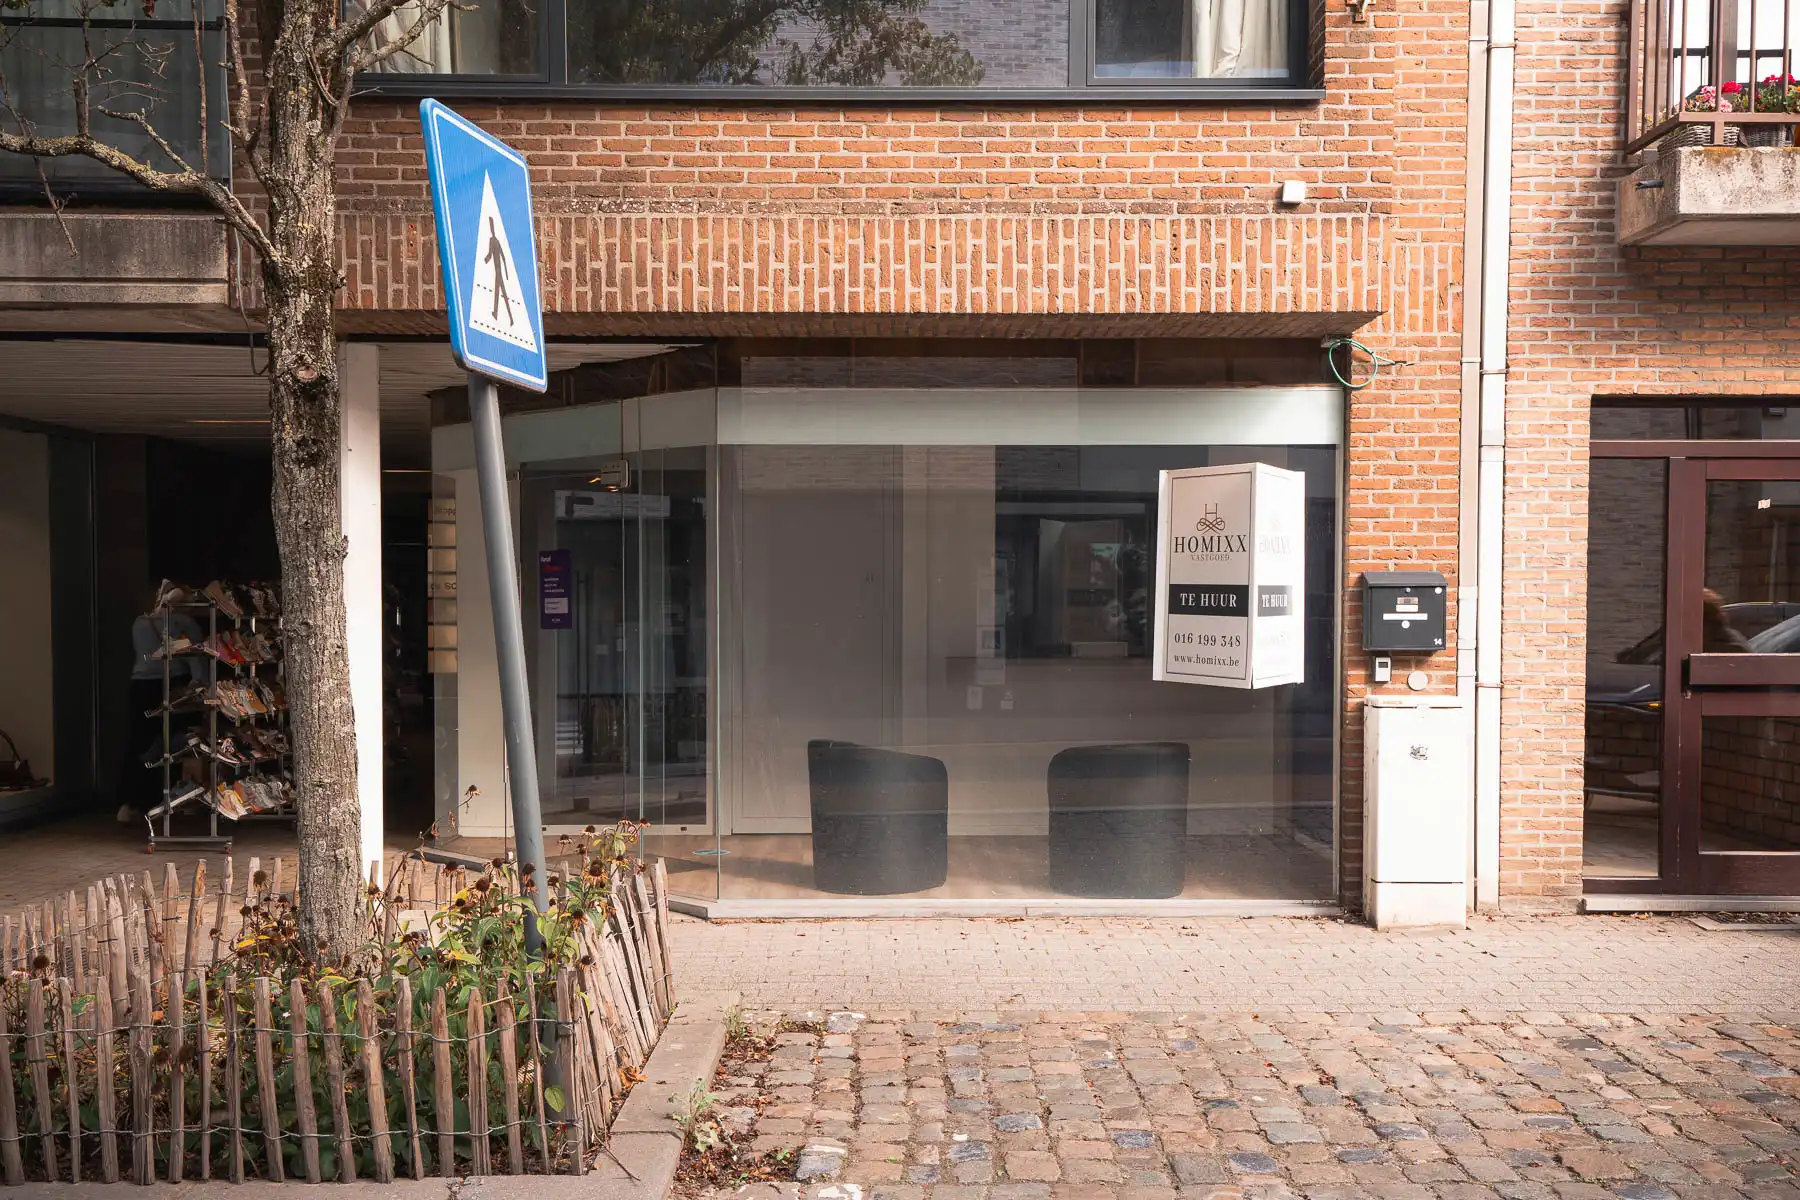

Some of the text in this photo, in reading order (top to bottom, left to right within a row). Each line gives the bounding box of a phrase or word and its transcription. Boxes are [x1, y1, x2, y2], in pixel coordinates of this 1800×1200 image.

[1174, 534, 1247, 554] HOMIXX
[1190, 553, 1230, 561] VASTGOED
[1180, 593, 1237, 607] TE HUUR
[1262, 594, 1288, 607] TE HUUR
[1174, 632, 1241, 648] 016 199 348
[1174, 653, 1240, 667] www.homixx.be
